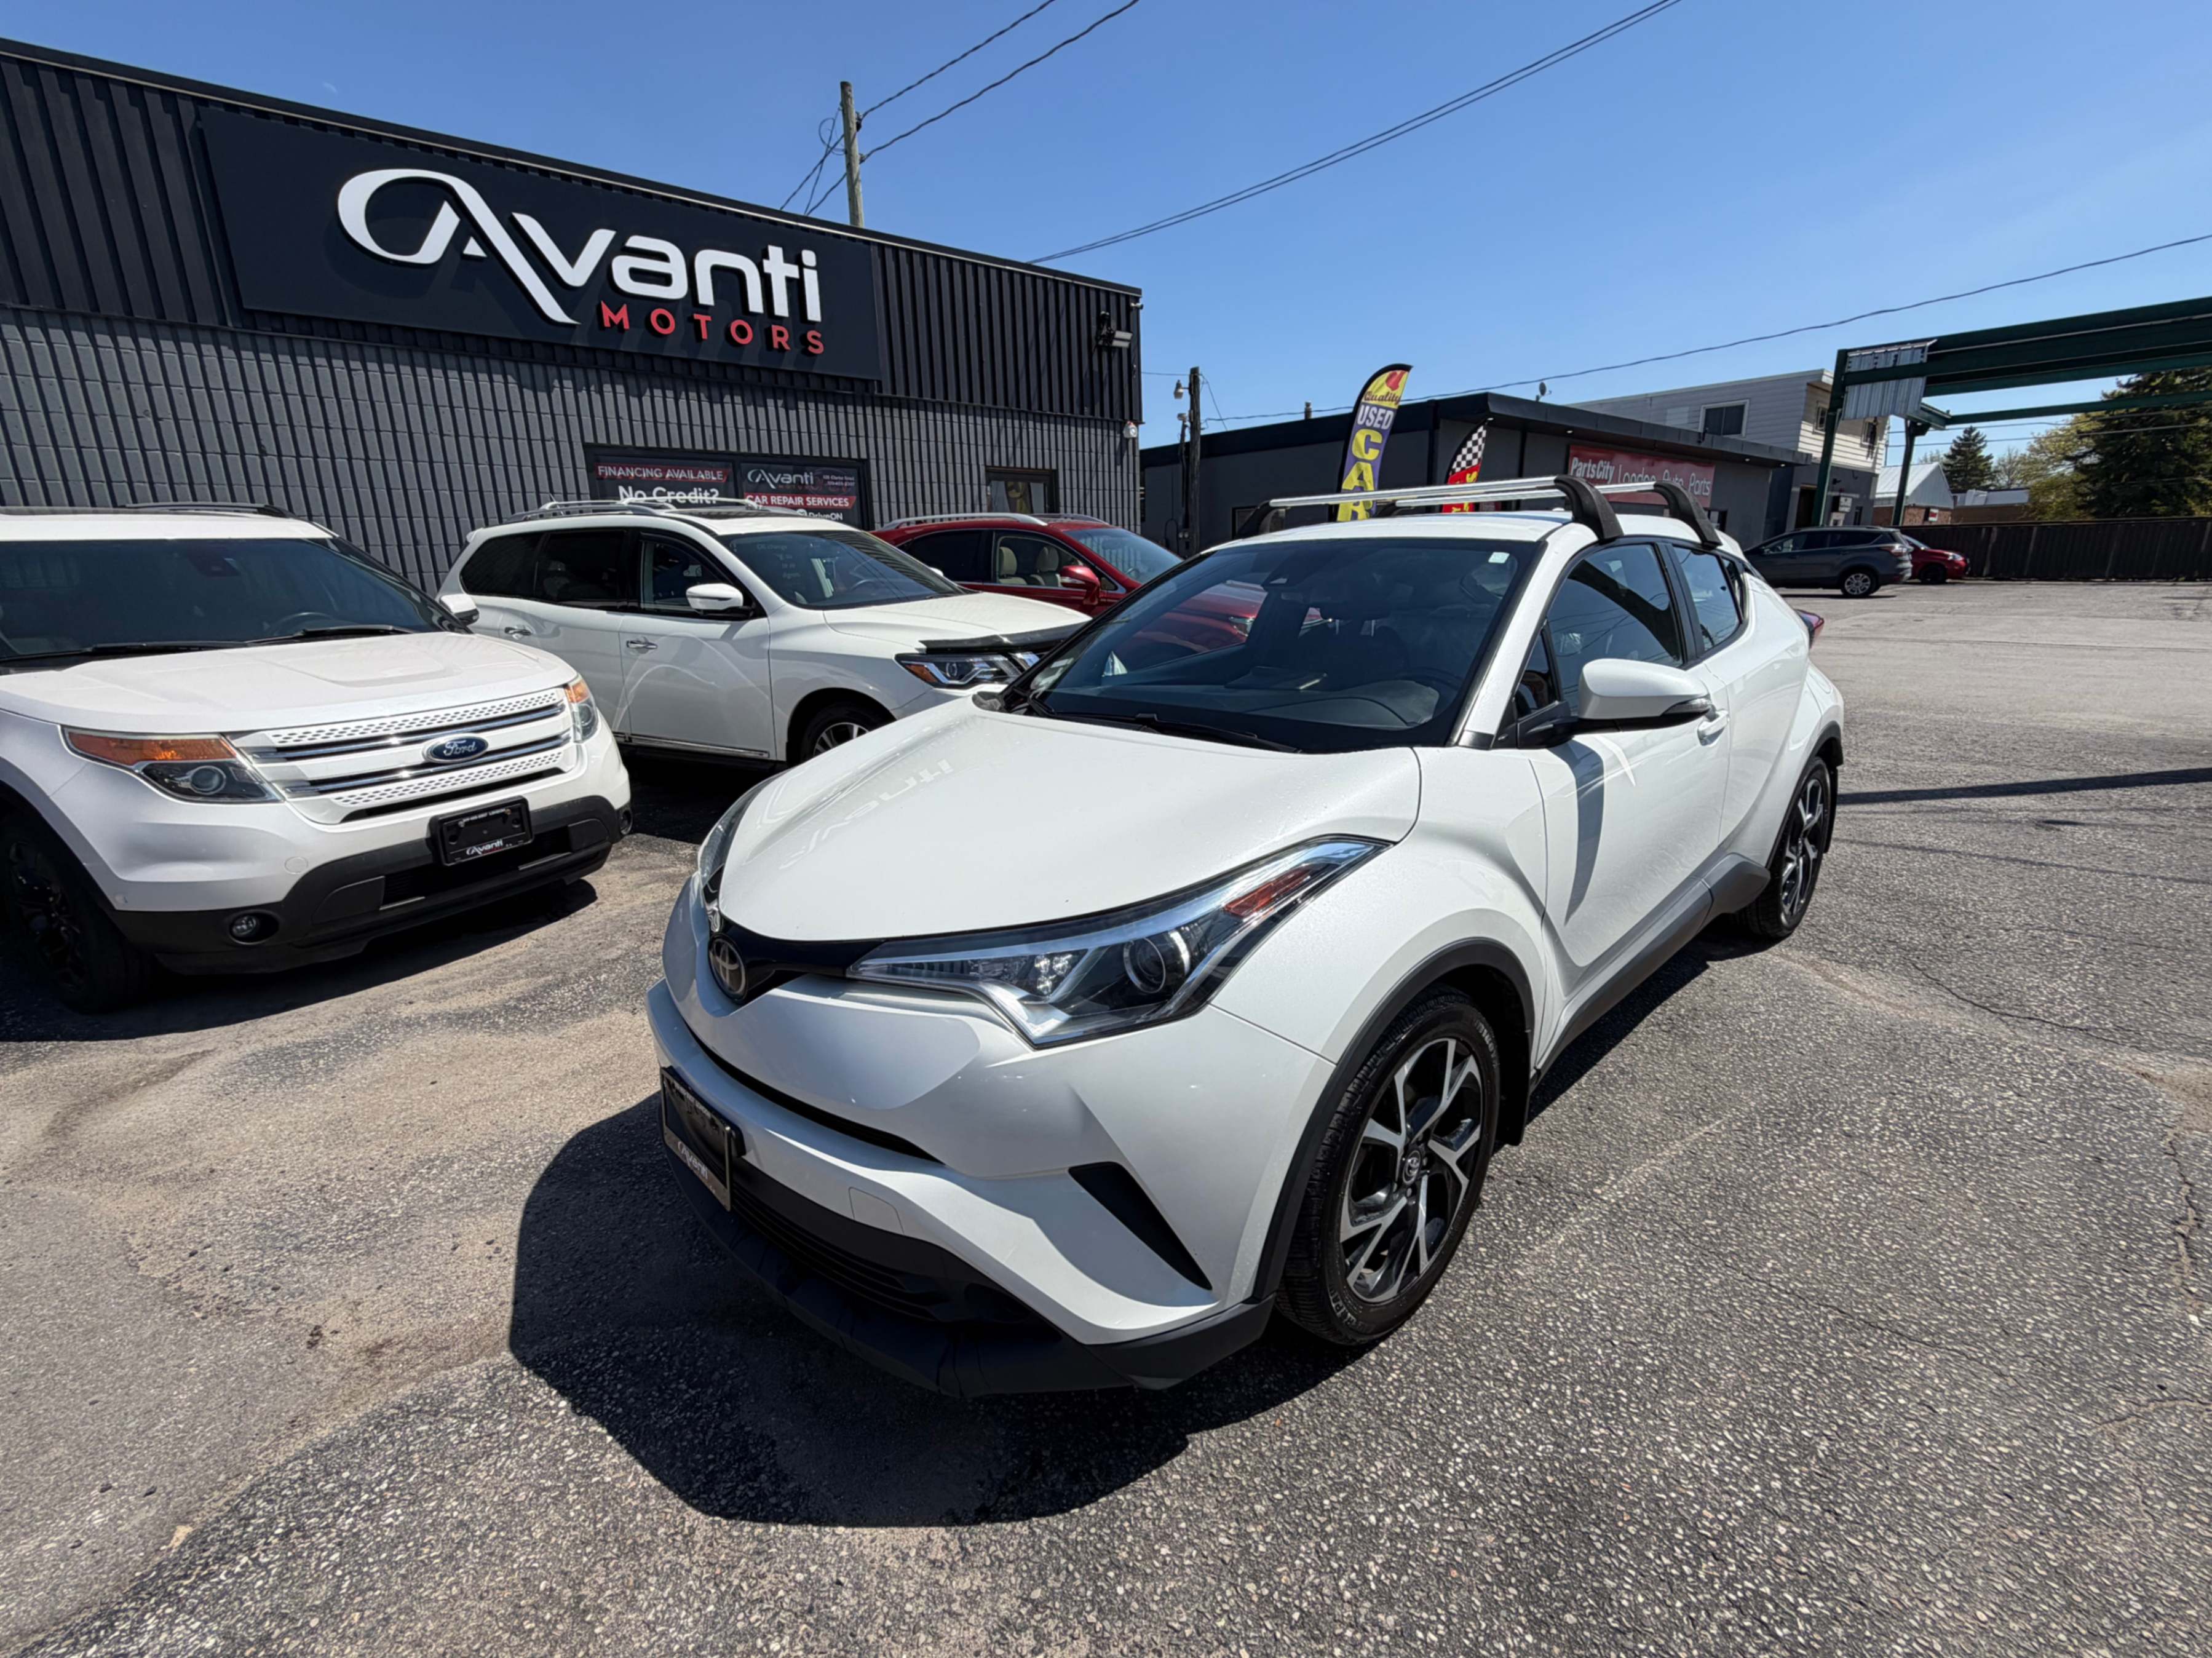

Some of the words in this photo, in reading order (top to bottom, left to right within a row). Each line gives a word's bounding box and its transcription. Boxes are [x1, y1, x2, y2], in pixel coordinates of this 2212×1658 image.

[338, 169, 821, 324] Avanti
[600, 301, 824, 355] MOTORS
[1365, 391, 1401, 405] Quality
[1357, 405, 1394, 429] USED
[598, 466, 662, 478] FINANCING
[665, 469, 723, 480] AVAILABLE
[747, 469, 814, 489] Avanti
[1570, 456, 1615, 484] PartsCity
[1688, 472, 1711, 496] Parts
[618, 485, 647, 502] No
[652, 486, 719, 504] Credit?
[746, 494, 768, 504] CAR
[771, 495, 804, 506] REPAIR
[806, 497, 849, 507] SERVICES
[443, 740, 477, 756] Ford
[466, 838, 504, 855] Avanti
